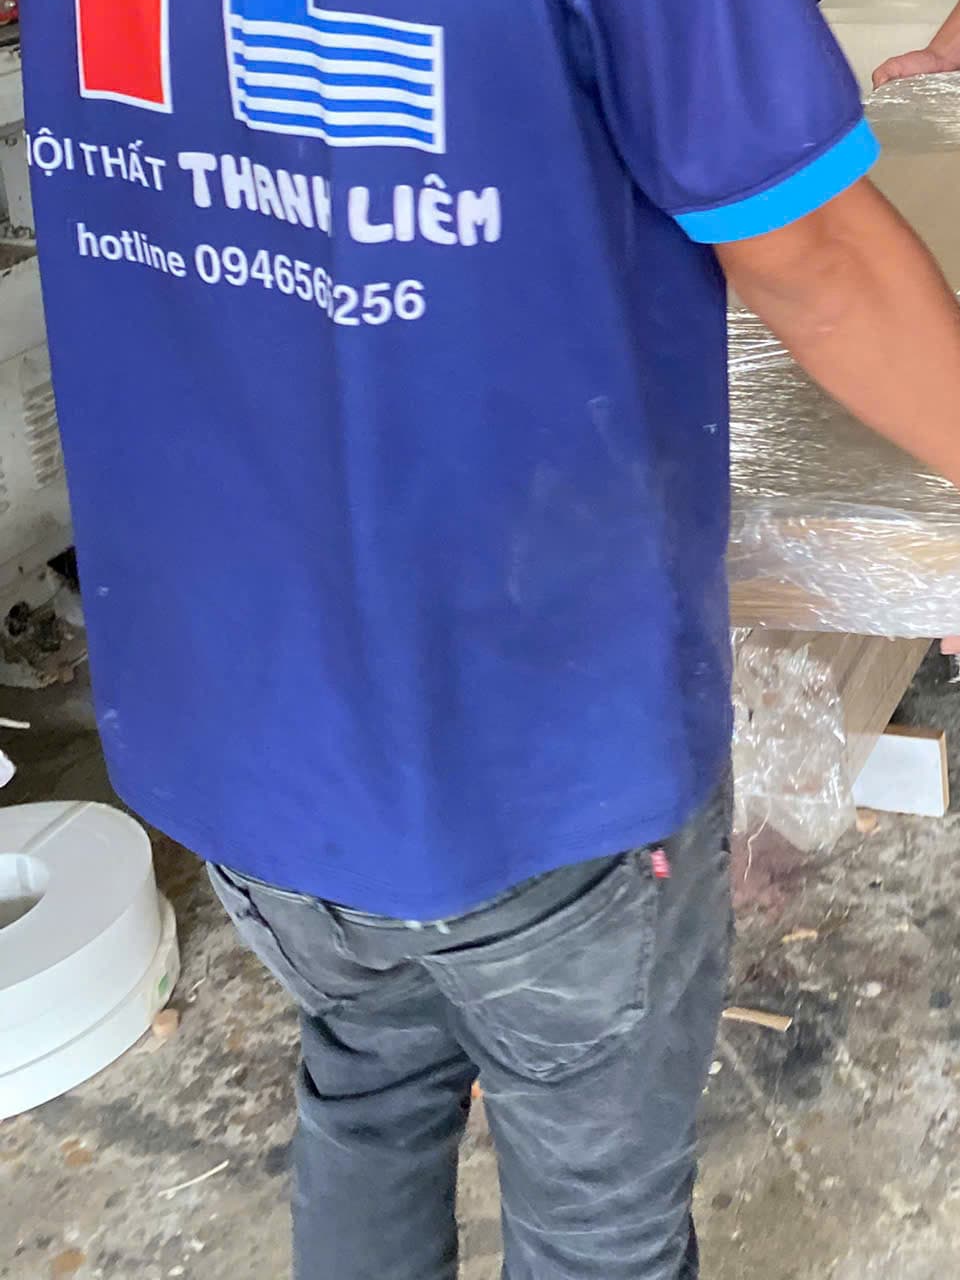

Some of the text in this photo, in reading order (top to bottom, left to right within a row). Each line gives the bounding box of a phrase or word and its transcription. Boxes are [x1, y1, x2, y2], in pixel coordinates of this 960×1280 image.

[79, 139, 167, 191] THẤT
[347, 173, 501, 246] LIÊM
[77, 223, 188, 278] hotline
